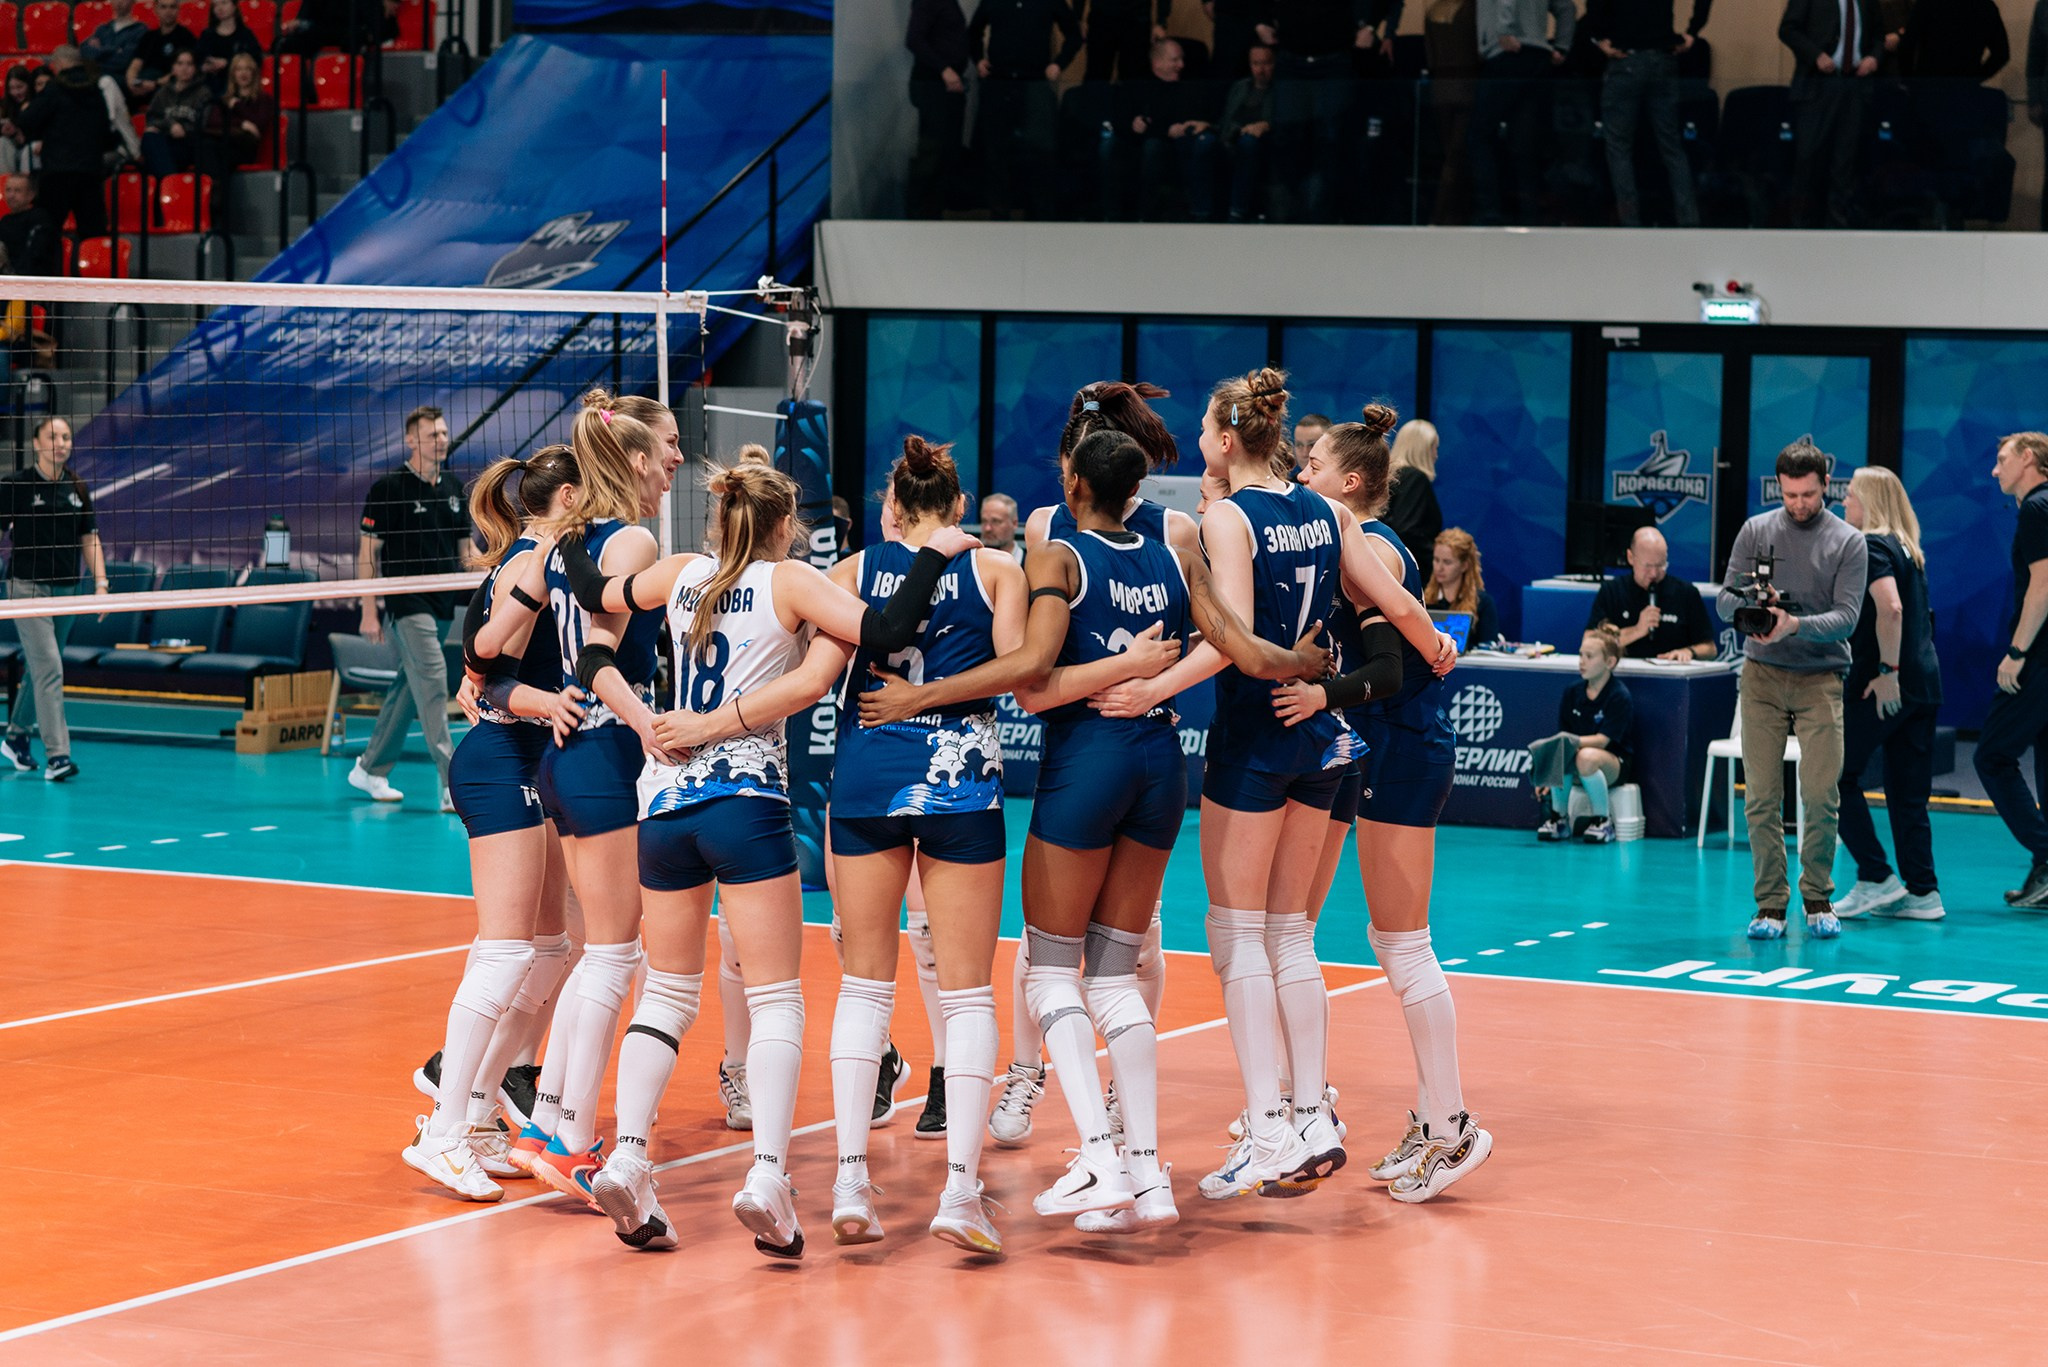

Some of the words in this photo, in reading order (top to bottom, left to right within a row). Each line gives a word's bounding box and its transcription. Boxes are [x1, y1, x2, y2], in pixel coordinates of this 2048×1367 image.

[1618, 475, 1705, 498] КОРАБЕЛКА
[1295, 564, 1316, 645] 7
[679, 630, 730, 715] 18
[1455, 746, 1533, 774] ЕРЛИГА
[536, 1092, 561, 1105] rrea
[755, 1153, 778, 1164] rrea
